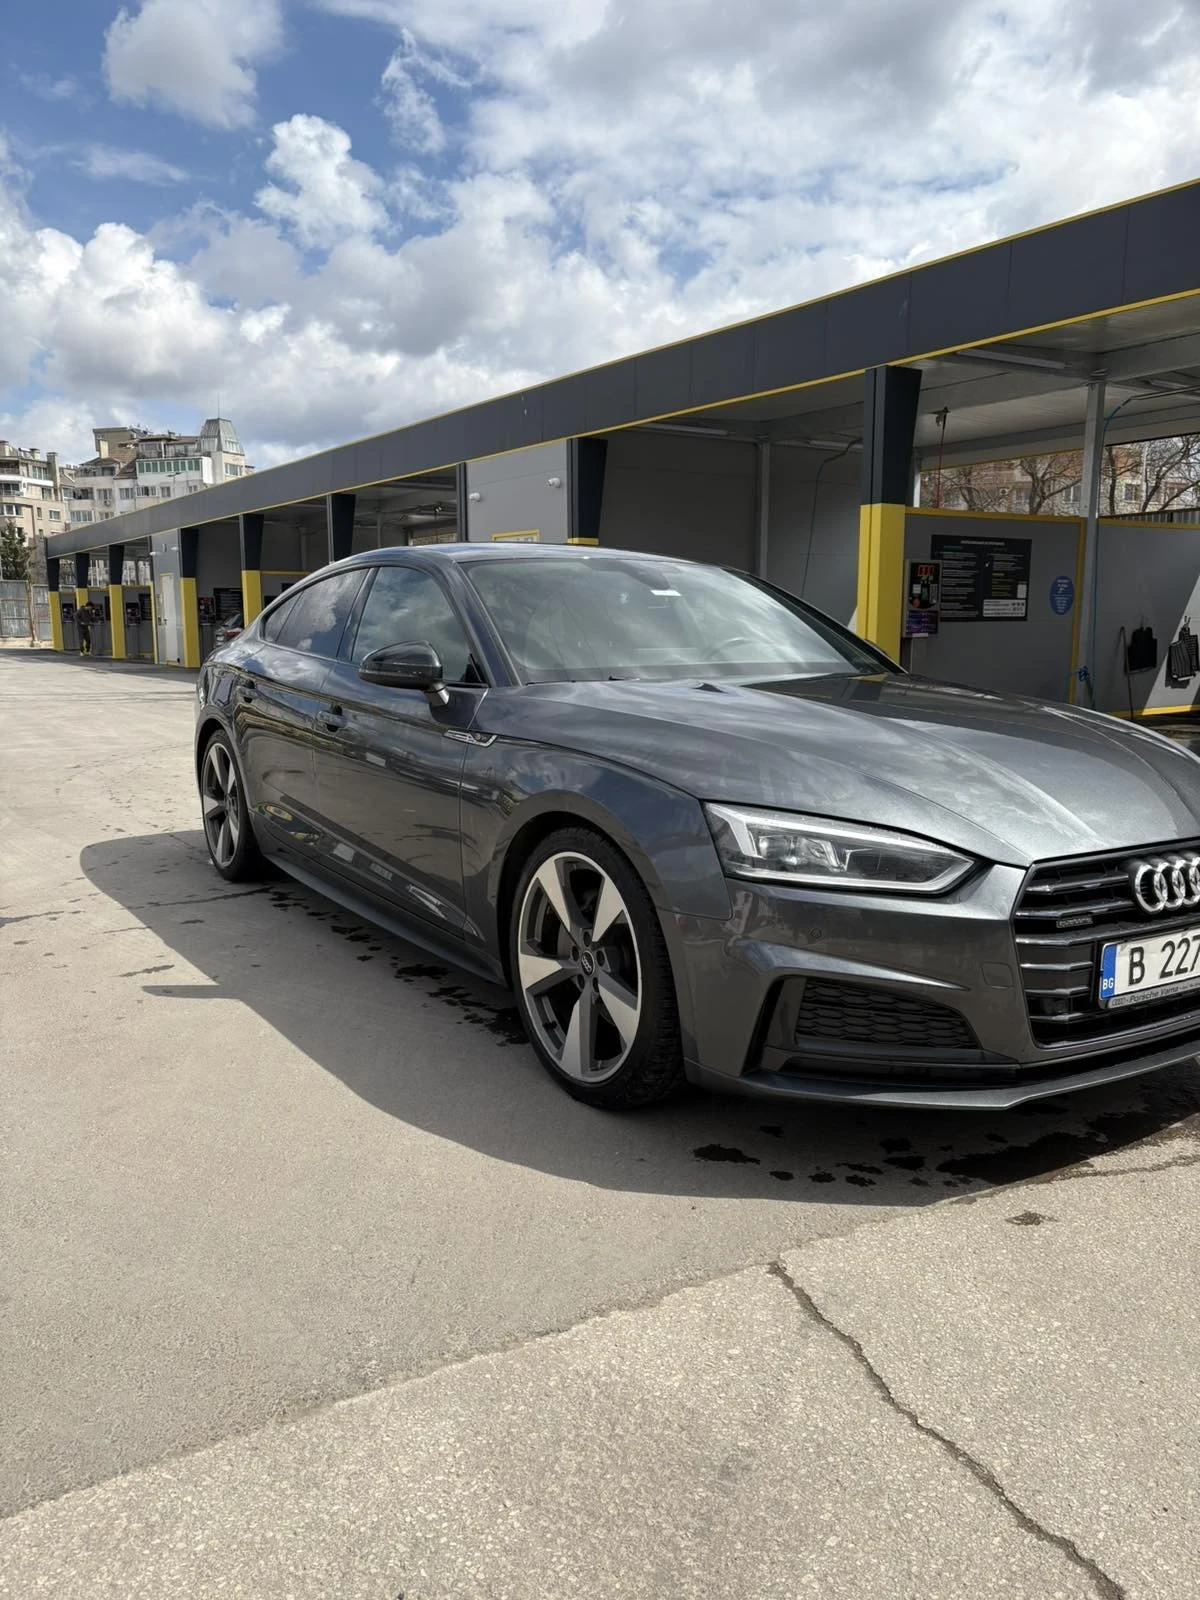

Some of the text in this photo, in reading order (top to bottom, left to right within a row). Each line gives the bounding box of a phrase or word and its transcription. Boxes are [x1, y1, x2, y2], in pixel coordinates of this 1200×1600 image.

[1129, 934, 1200, 986] B 227
[1103, 978, 1114, 989] BG
